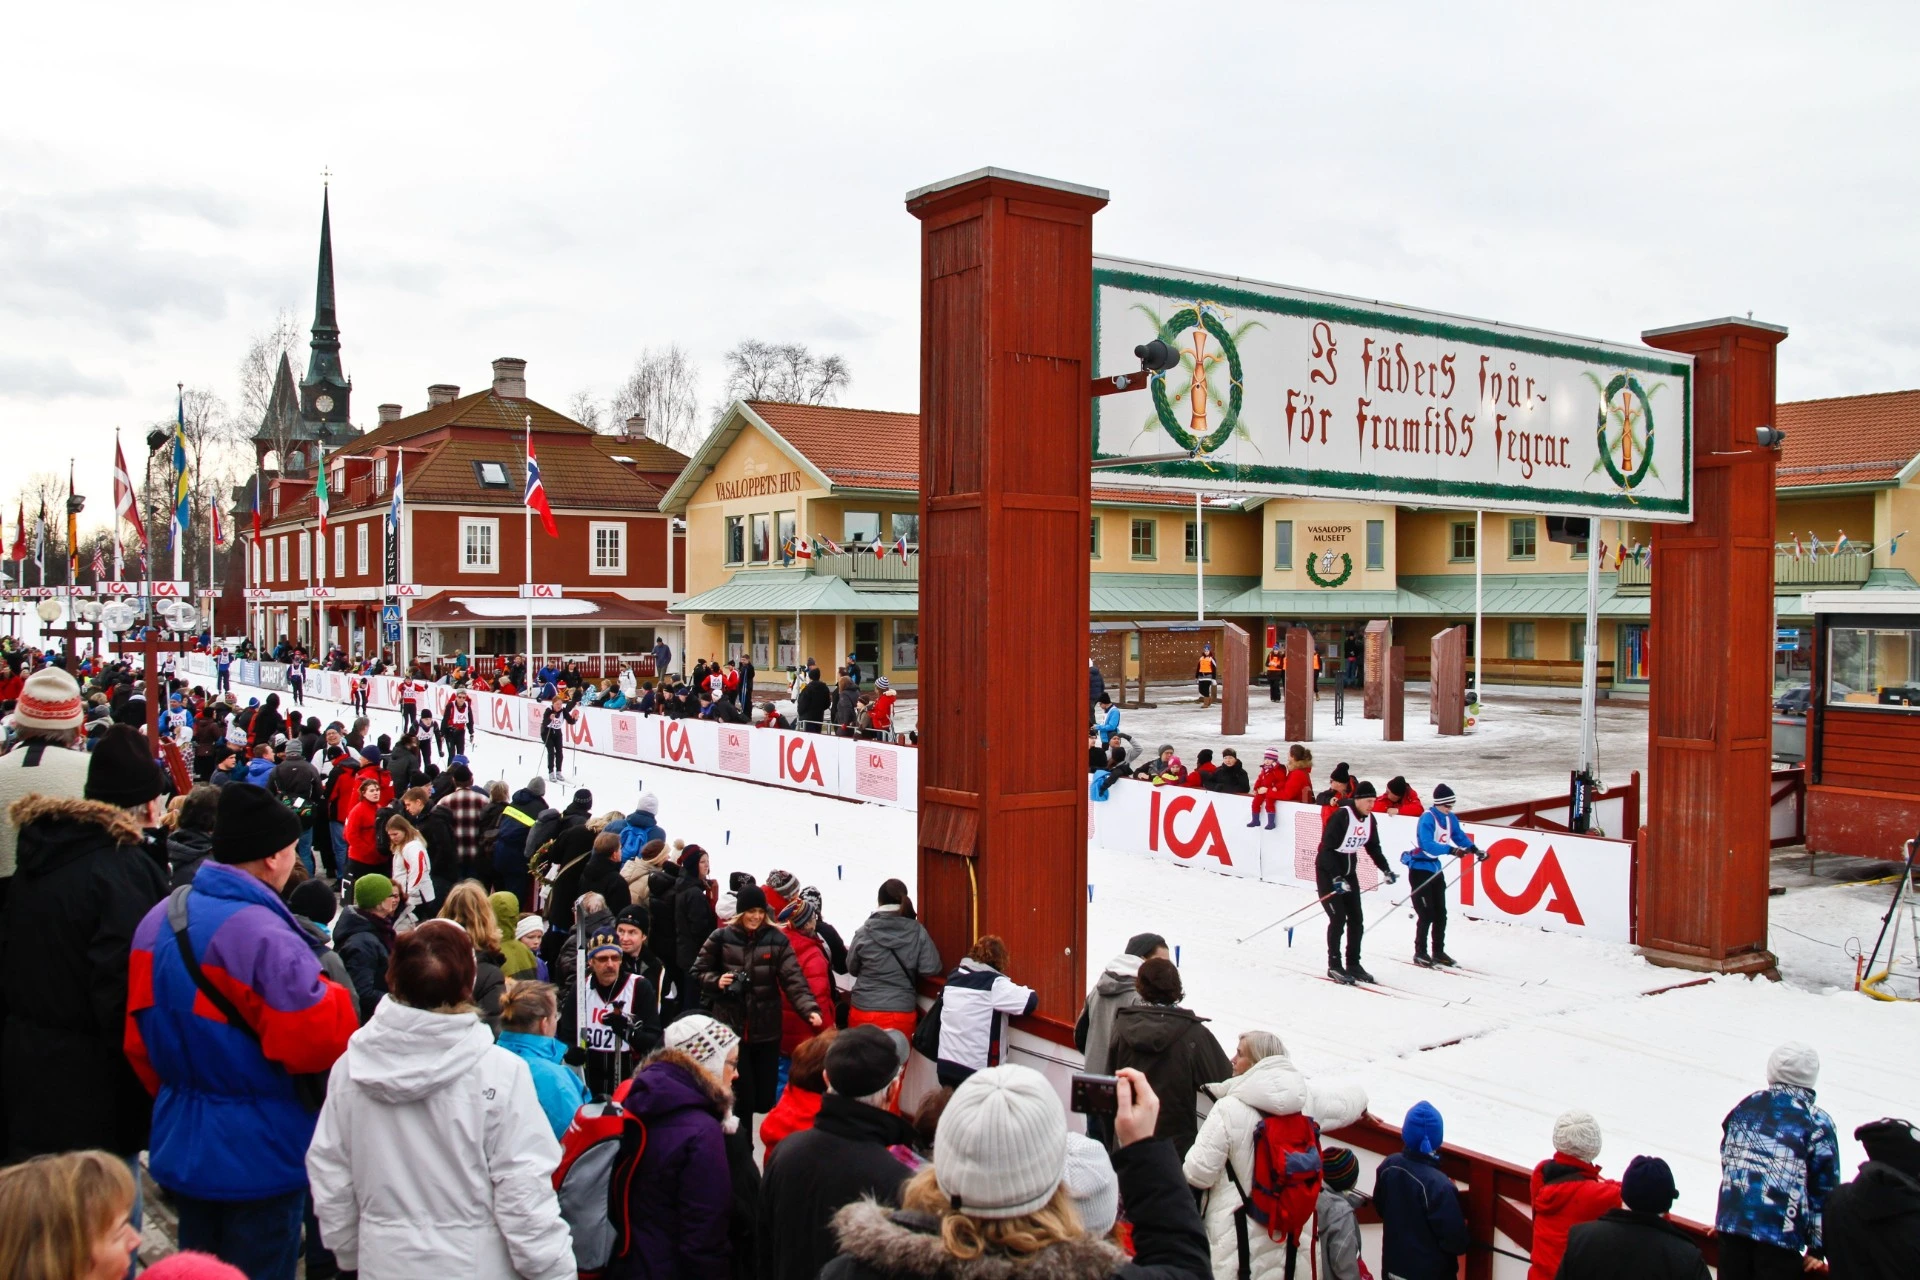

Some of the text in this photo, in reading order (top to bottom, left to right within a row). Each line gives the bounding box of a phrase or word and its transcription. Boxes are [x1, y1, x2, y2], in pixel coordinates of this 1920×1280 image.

[715, 470, 801, 501] VASALOPPETS HUS
[1313, 534, 1345, 542] MUSEET
[36, 588, 52, 596] ICA
[65, 586, 83, 596] ICA
[107, 582, 128, 593] ICA
[152, 582, 178, 595] ICA
[251, 589, 265, 597] ICA
[312, 588, 328, 597] ICA
[396, 585, 414, 595] ICA
[532, 584, 554, 597] ICA
[391, 624, 398, 634] P
[261, 665, 280, 684] CRAFT
[491, 697, 514, 732] ICA
[533, 707, 542, 718] ICA
[566, 709, 593, 747] ICA
[619, 720, 628, 731] ICA
[660, 720, 694, 764] ICA
[728, 735, 739, 747] ICA
[779, 735, 824, 786] ICA
[869, 754, 884, 769] ICA
[1149, 791, 1233, 866] ICA
[1460, 833, 1585, 926] ICA
